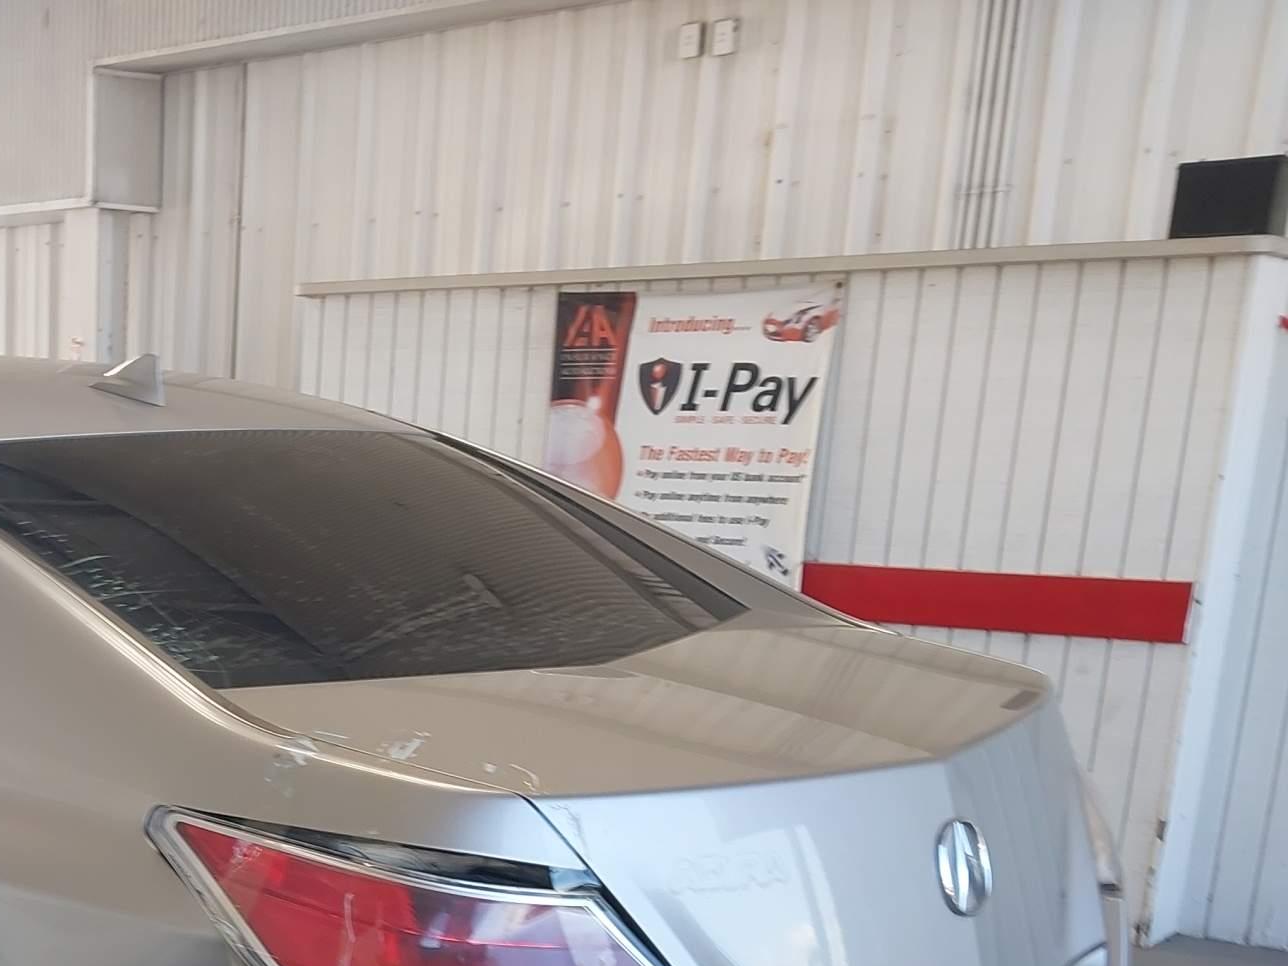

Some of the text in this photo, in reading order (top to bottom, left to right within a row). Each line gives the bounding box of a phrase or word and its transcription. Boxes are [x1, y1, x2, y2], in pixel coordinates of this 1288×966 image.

[679, 362, 819, 425] I-Pay
[639, 445, 810, 467] The Fastest Way to Pay!
